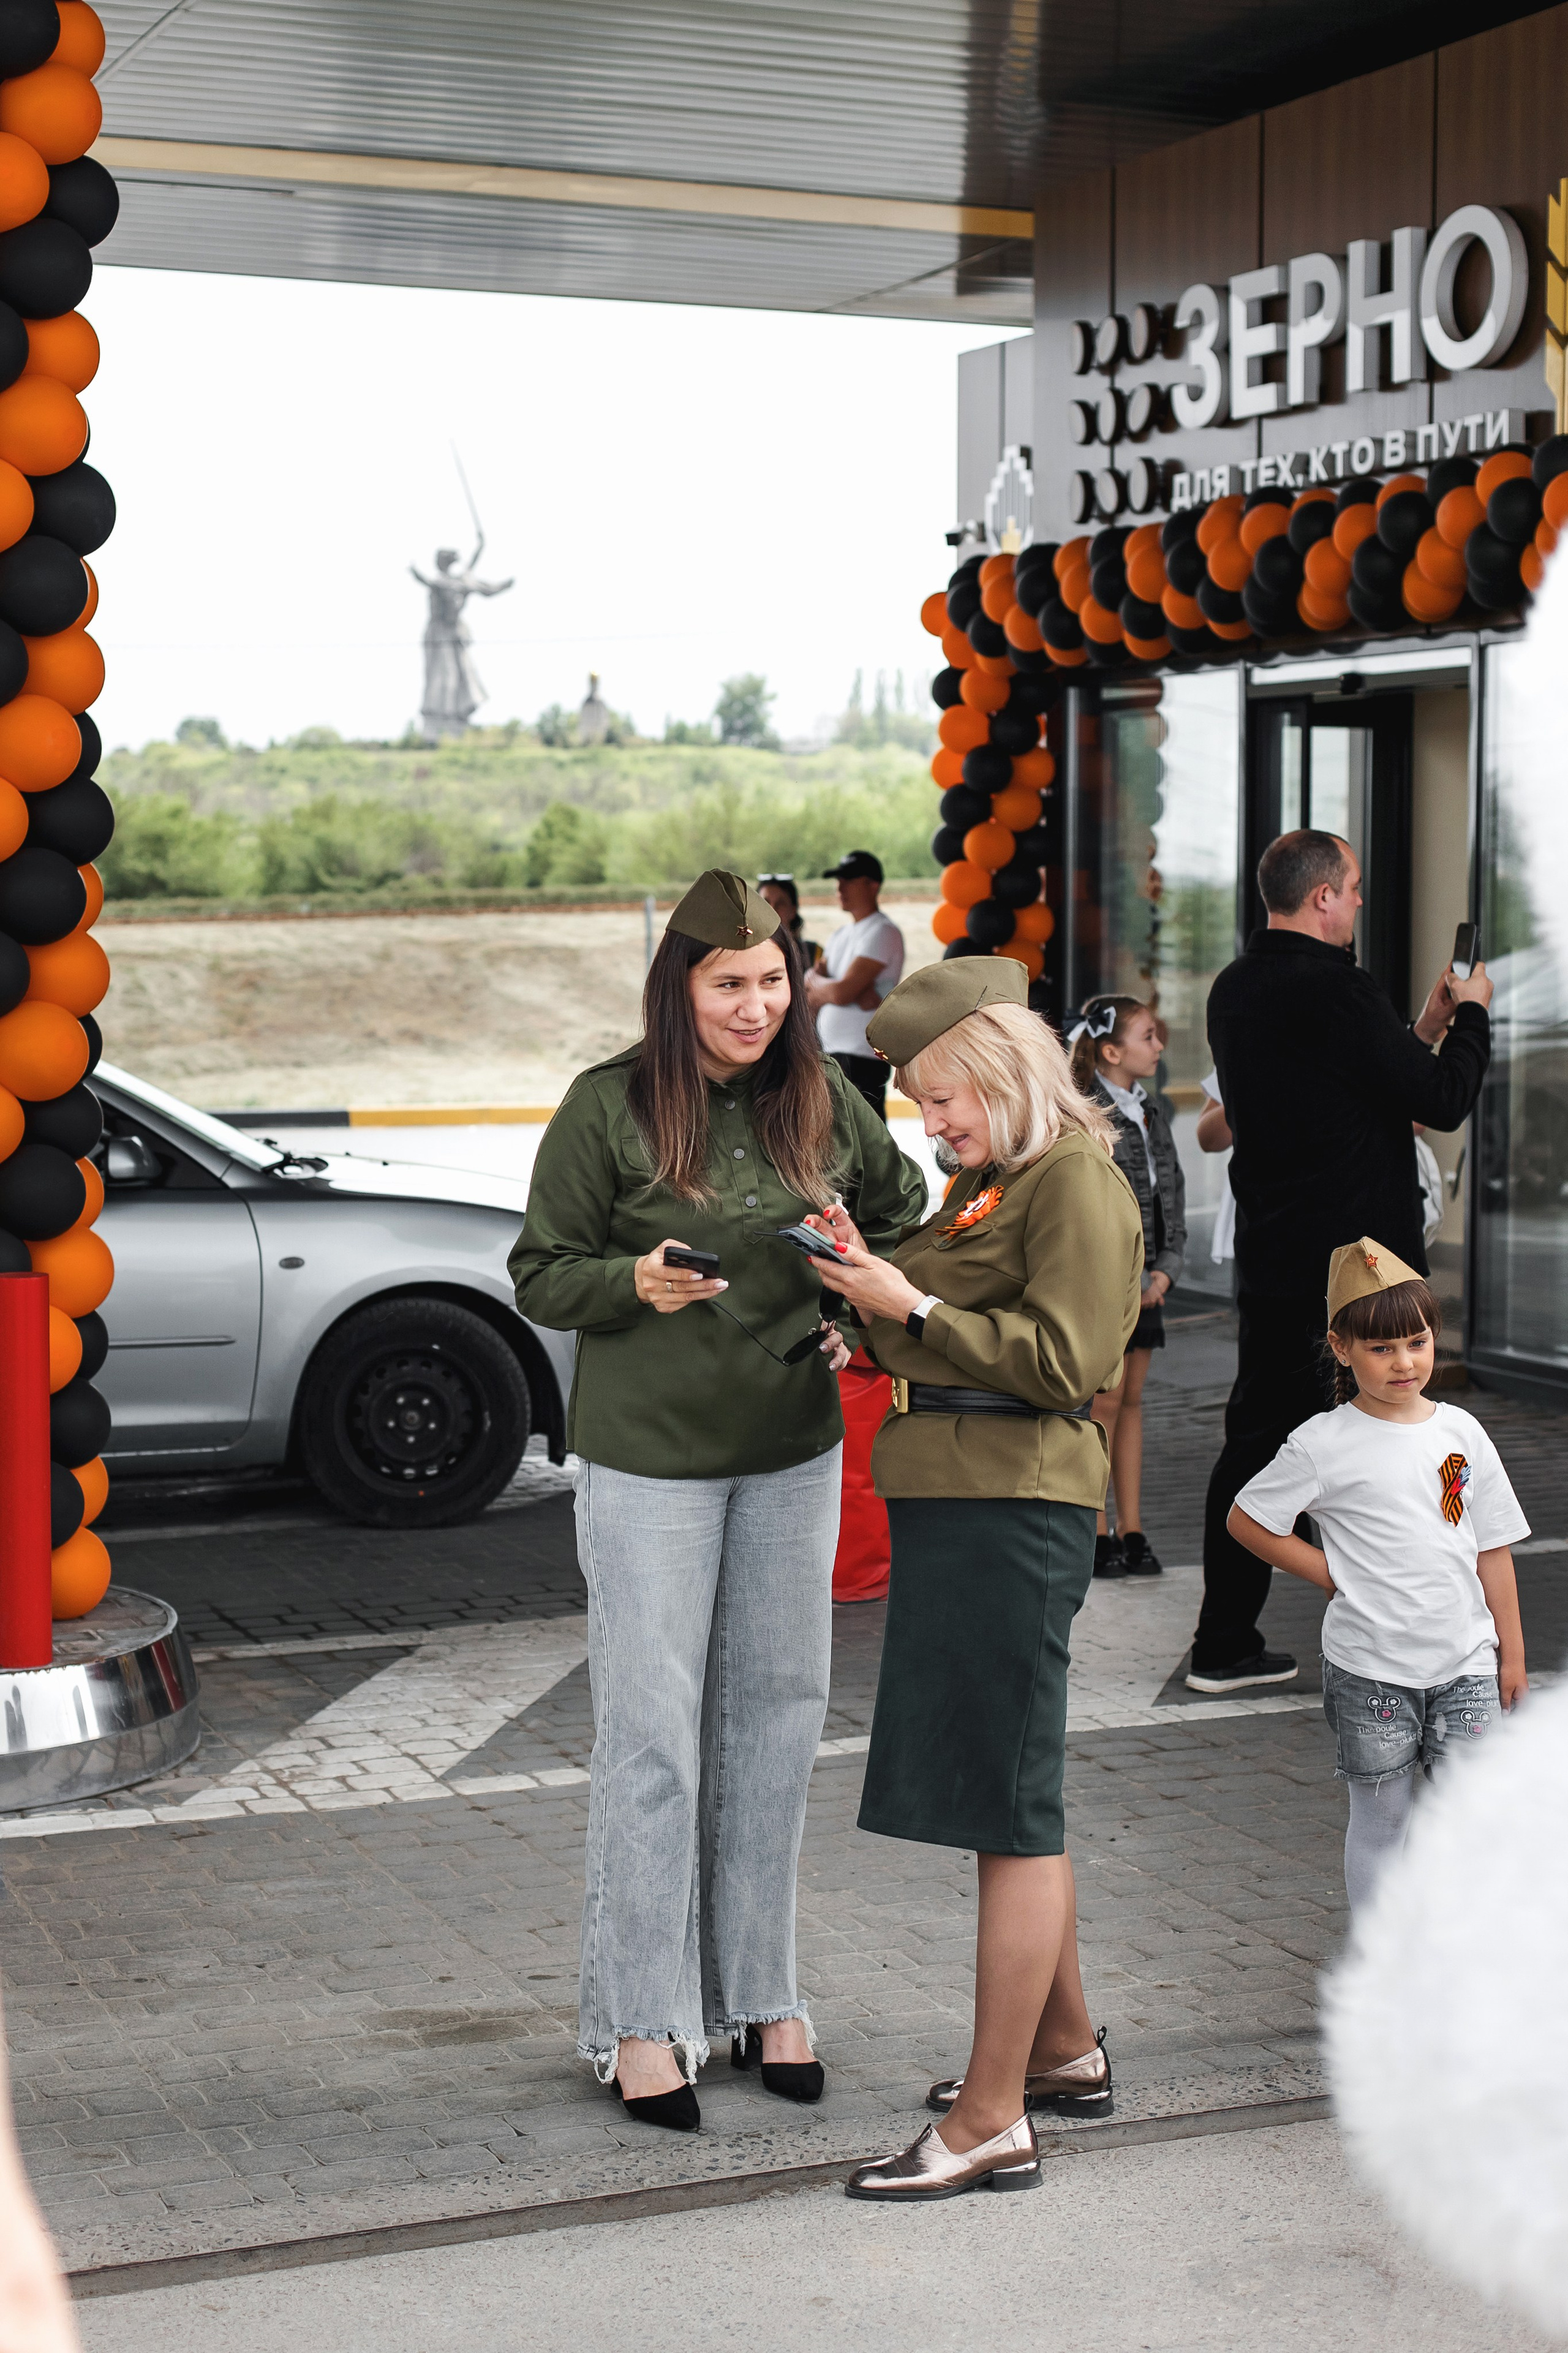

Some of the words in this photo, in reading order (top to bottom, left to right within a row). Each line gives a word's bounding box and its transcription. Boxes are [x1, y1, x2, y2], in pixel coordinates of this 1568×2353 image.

[1170, 204, 1528, 429] ЗЕРНО
[1170, 464, 1230, 513] ДЛЯ
[1308, 436, 1376, 483] КТО
[1383, 428, 1407, 468] В
[1417, 407, 1510, 463] ПУТИ
[1384, 1729, 1407, 1739] Cause
